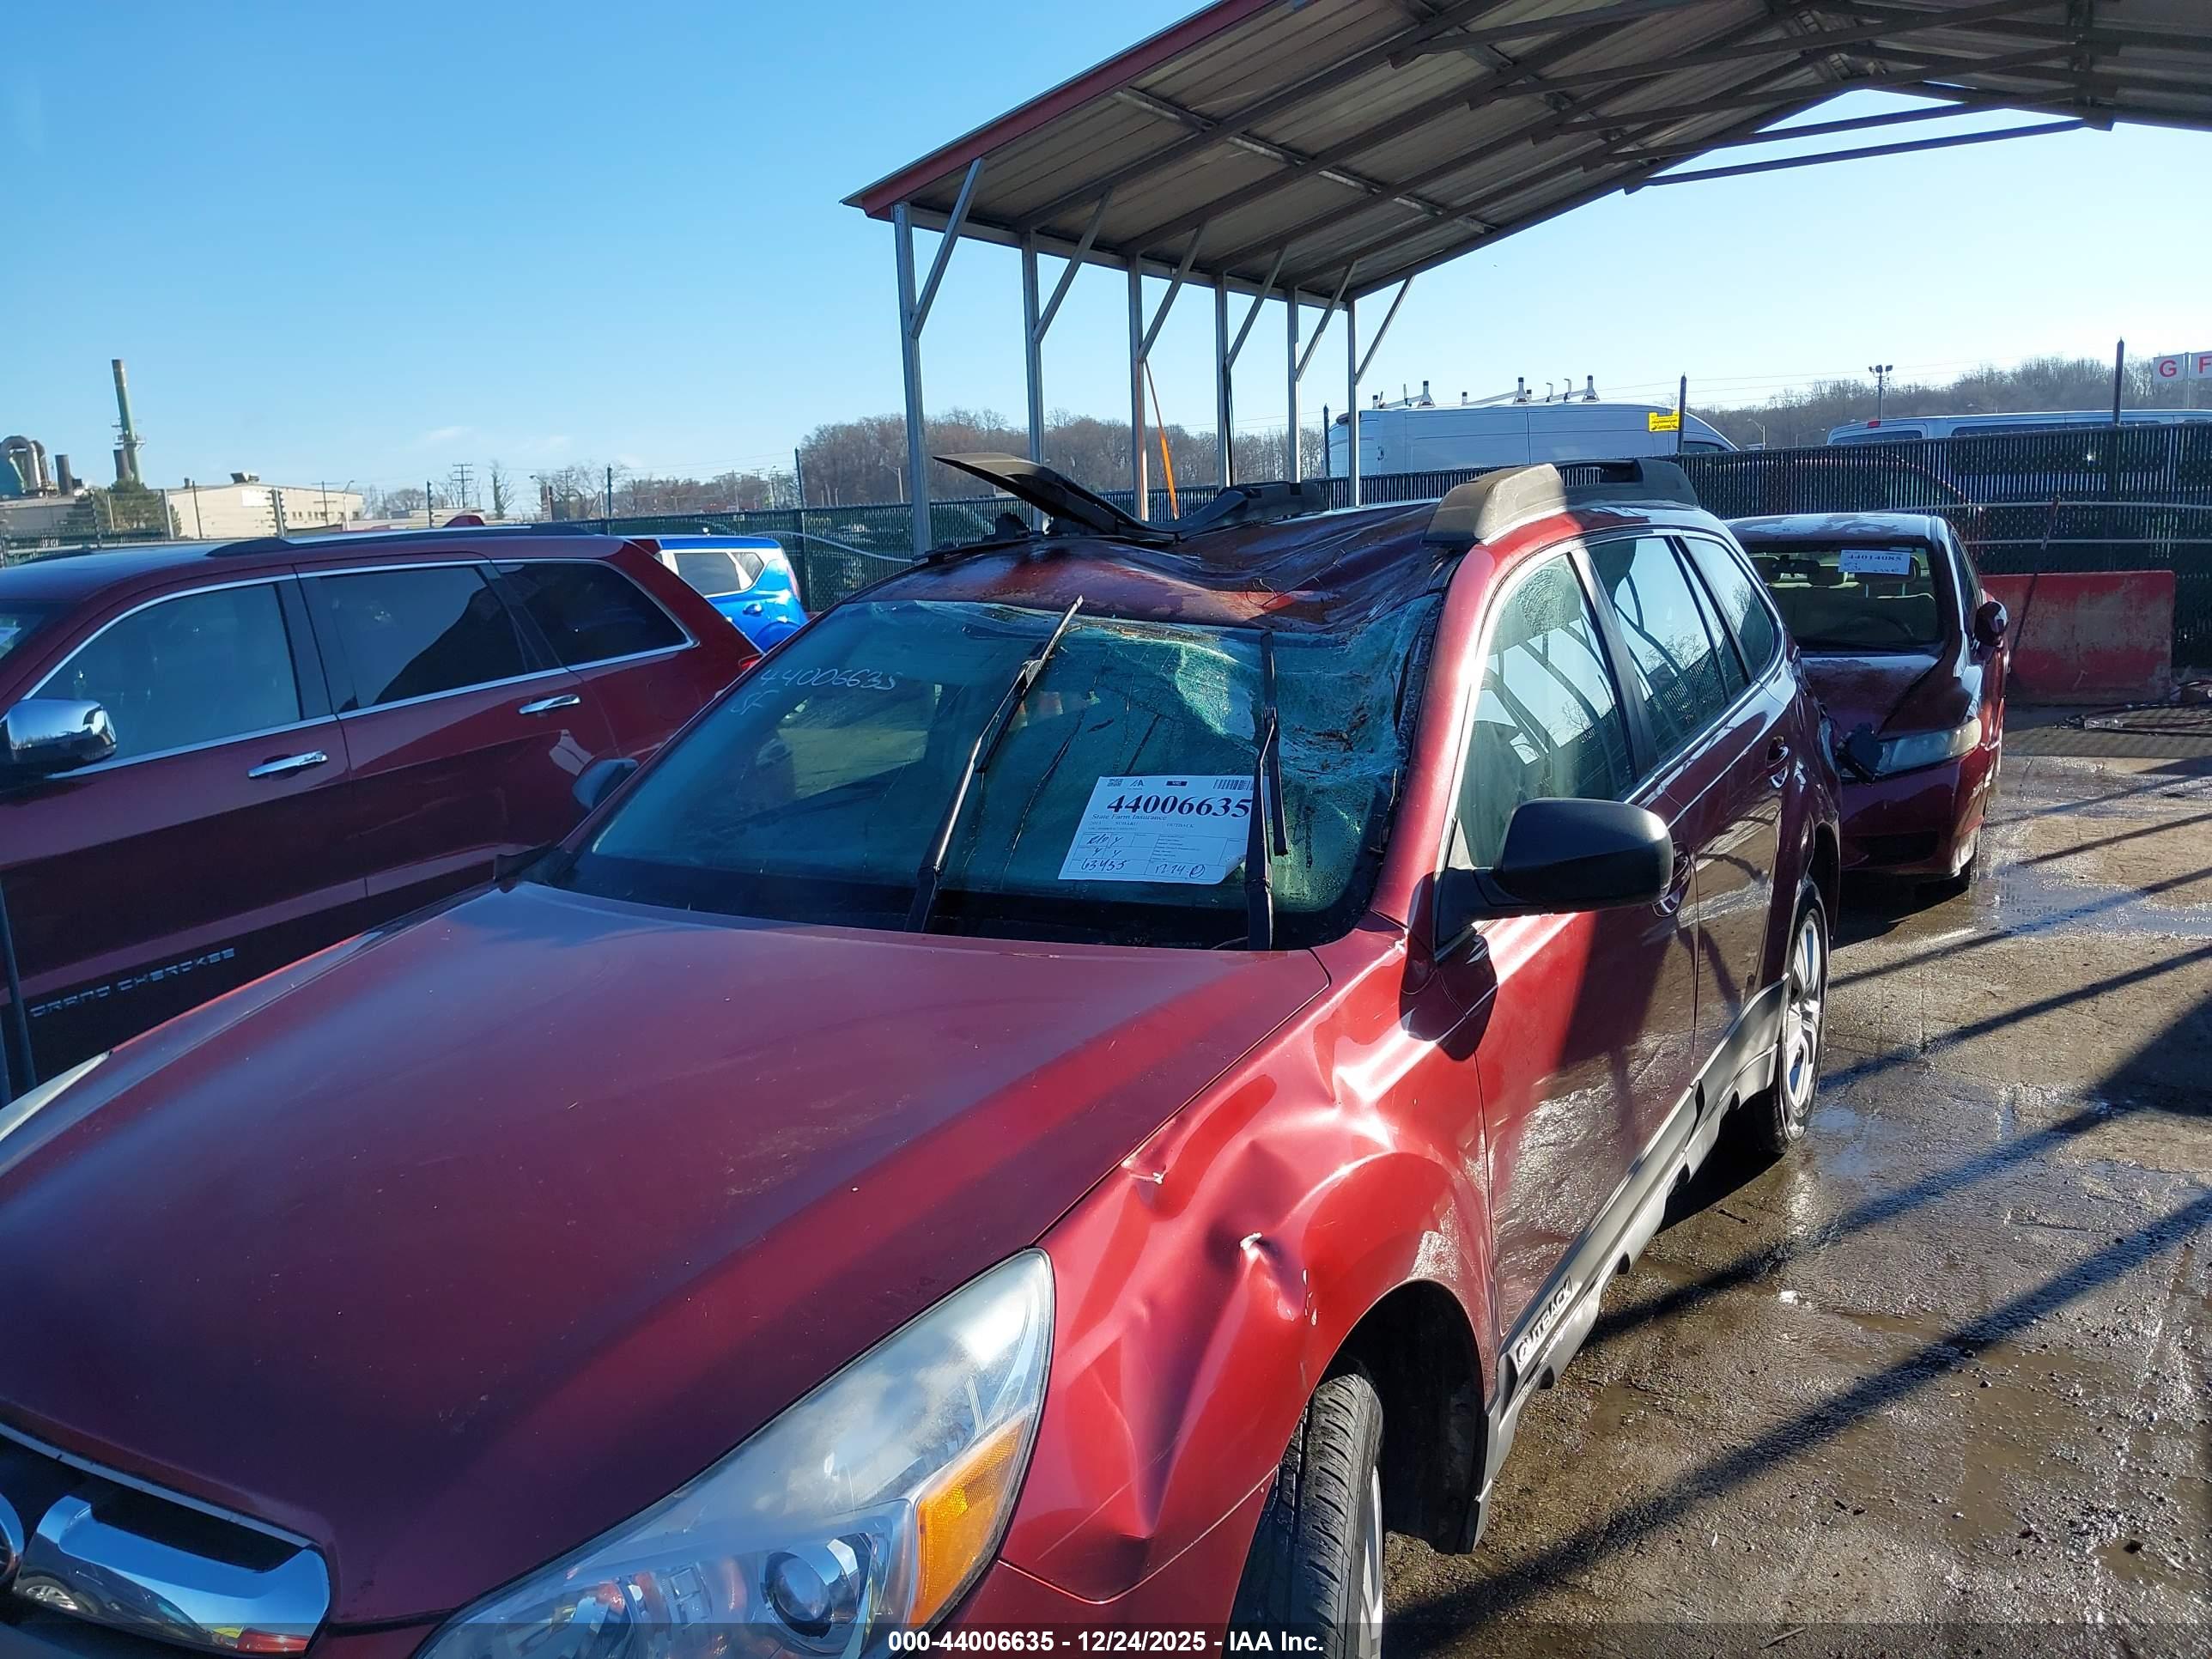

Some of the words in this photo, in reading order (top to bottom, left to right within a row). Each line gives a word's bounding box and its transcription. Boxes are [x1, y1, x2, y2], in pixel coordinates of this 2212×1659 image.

[2159, 360, 2178, 378] G
[760, 667, 903, 690] 44006635
[1106, 794, 1253, 817] 44006635
[29, 985, 111, 1018] GRAND
[117, 947, 235, 991] CHEROKEE
